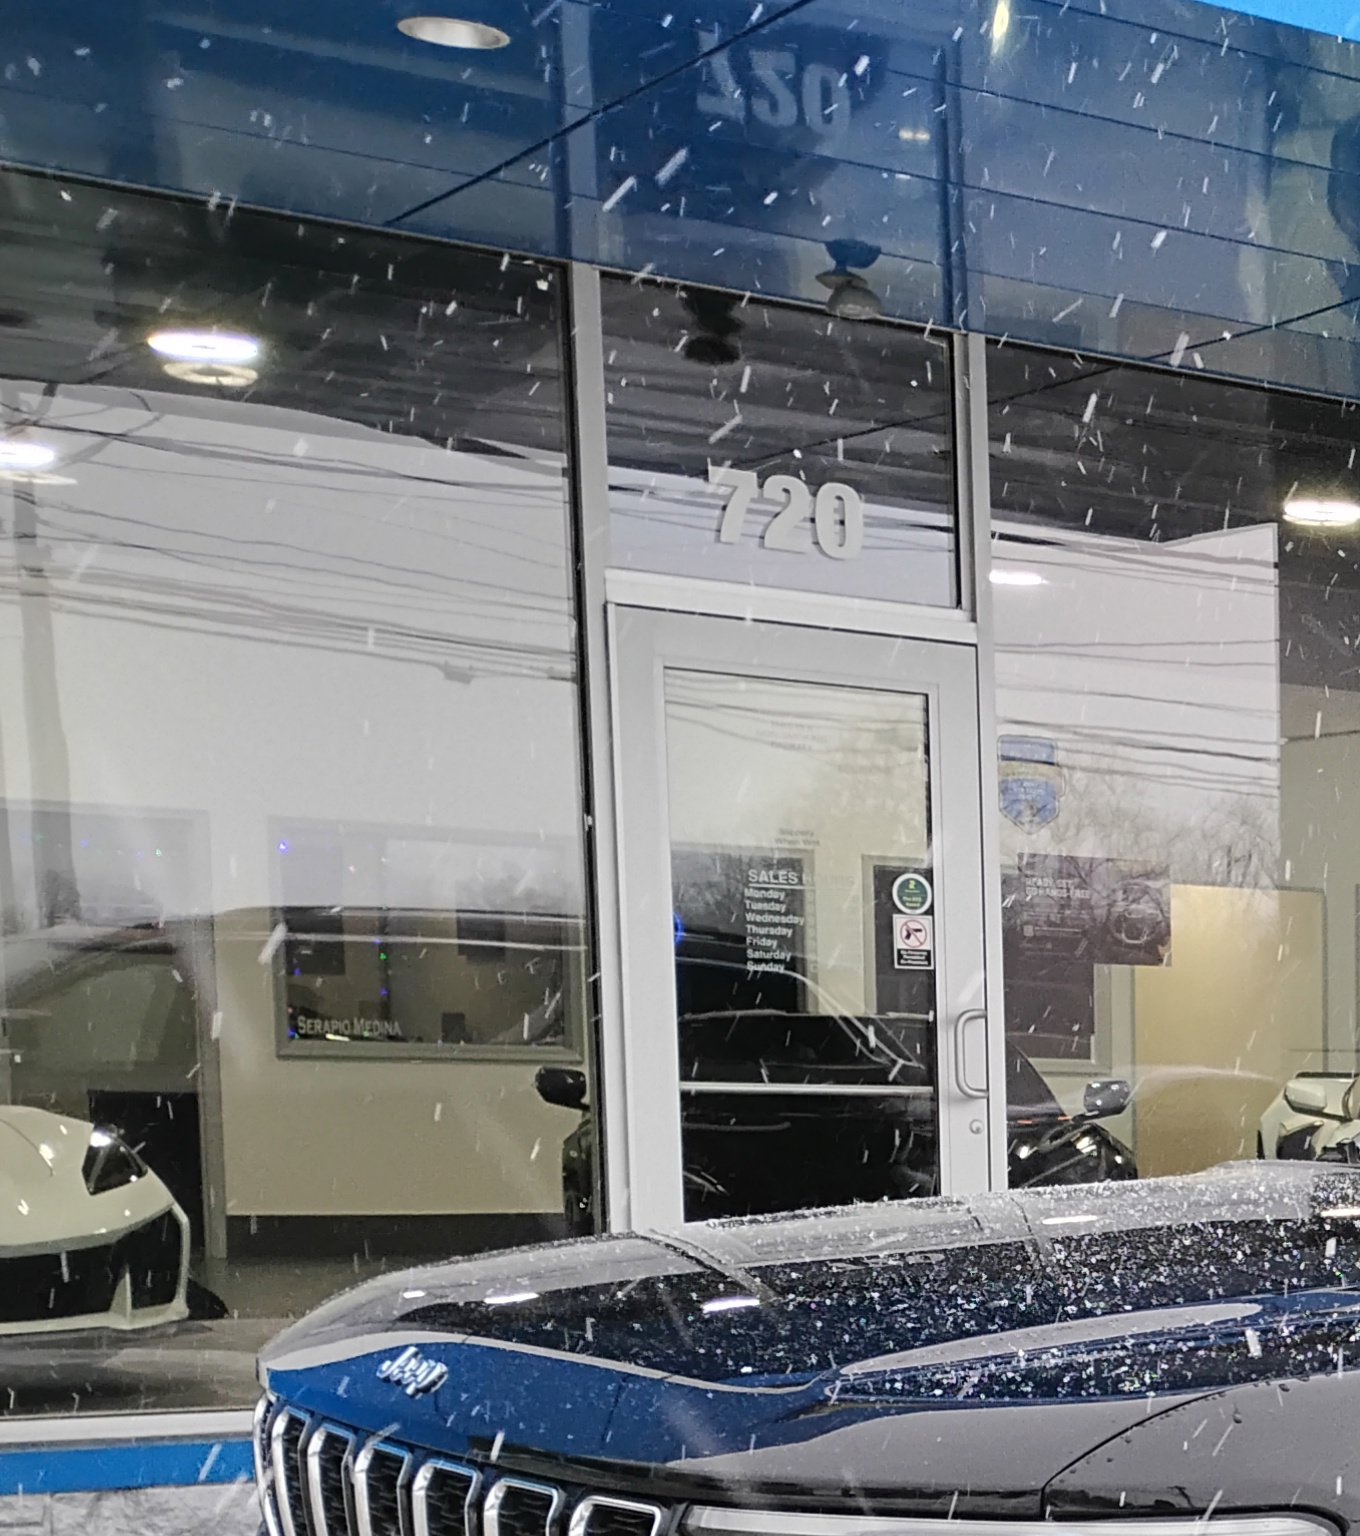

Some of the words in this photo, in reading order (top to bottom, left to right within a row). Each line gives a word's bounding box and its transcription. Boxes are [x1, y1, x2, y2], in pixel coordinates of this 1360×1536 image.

[708, 464, 865, 561] 720
[748, 868, 799, 885] SALES
[744, 887, 786, 901] Monday
[744, 899, 787, 914] Tuesday
[745, 911, 805, 926] Wednesday
[745, 924, 793, 938] Thursday
[746, 935, 778, 950] Friday
[746, 947, 792, 962] Saturday
[746, 960, 785, 974] Sunday
[298, 1015, 350, 1035] SERAPIO
[353, 1017, 402, 1037] MEDINA
